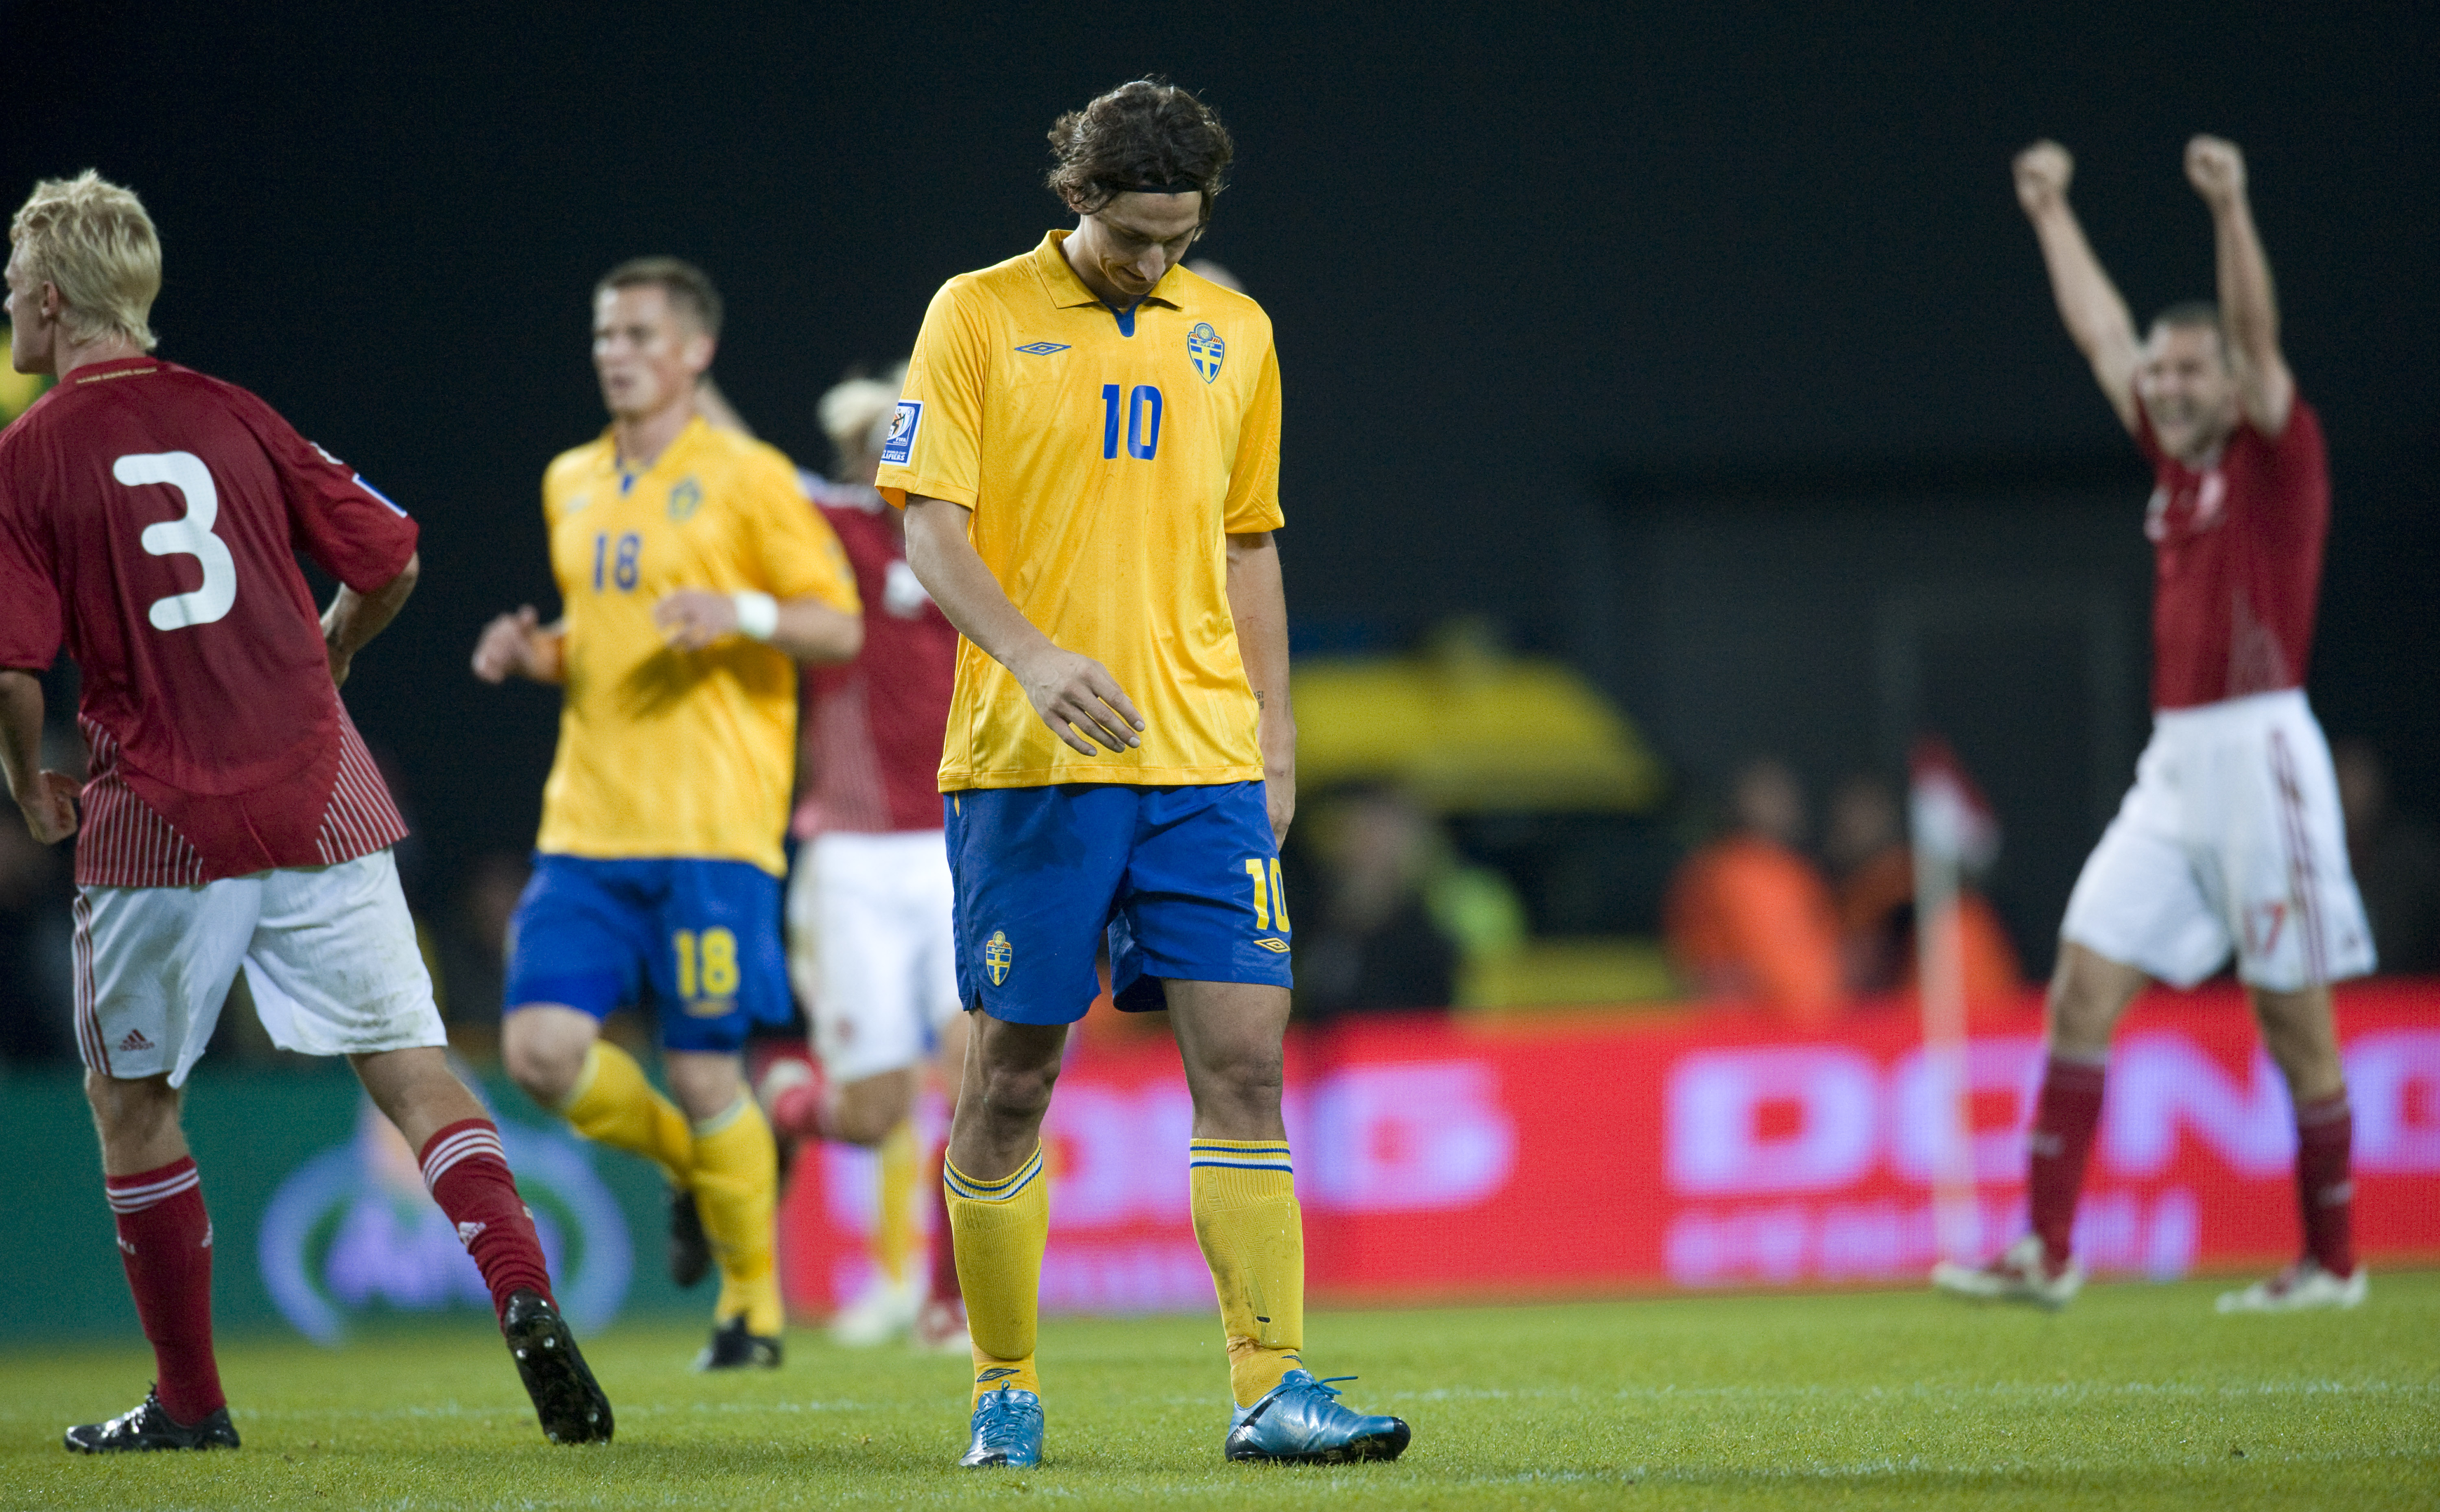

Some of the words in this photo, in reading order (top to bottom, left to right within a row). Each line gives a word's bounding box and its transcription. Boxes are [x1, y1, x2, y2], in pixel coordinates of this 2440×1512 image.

[881, 453, 905, 461] LIFIERS
[1102, 384, 1163, 460] 10
[113, 450, 237, 631] 3
[593, 532, 642, 592] 18
[1246, 857, 1290, 933] 10
[672, 926, 739, 999] 18
